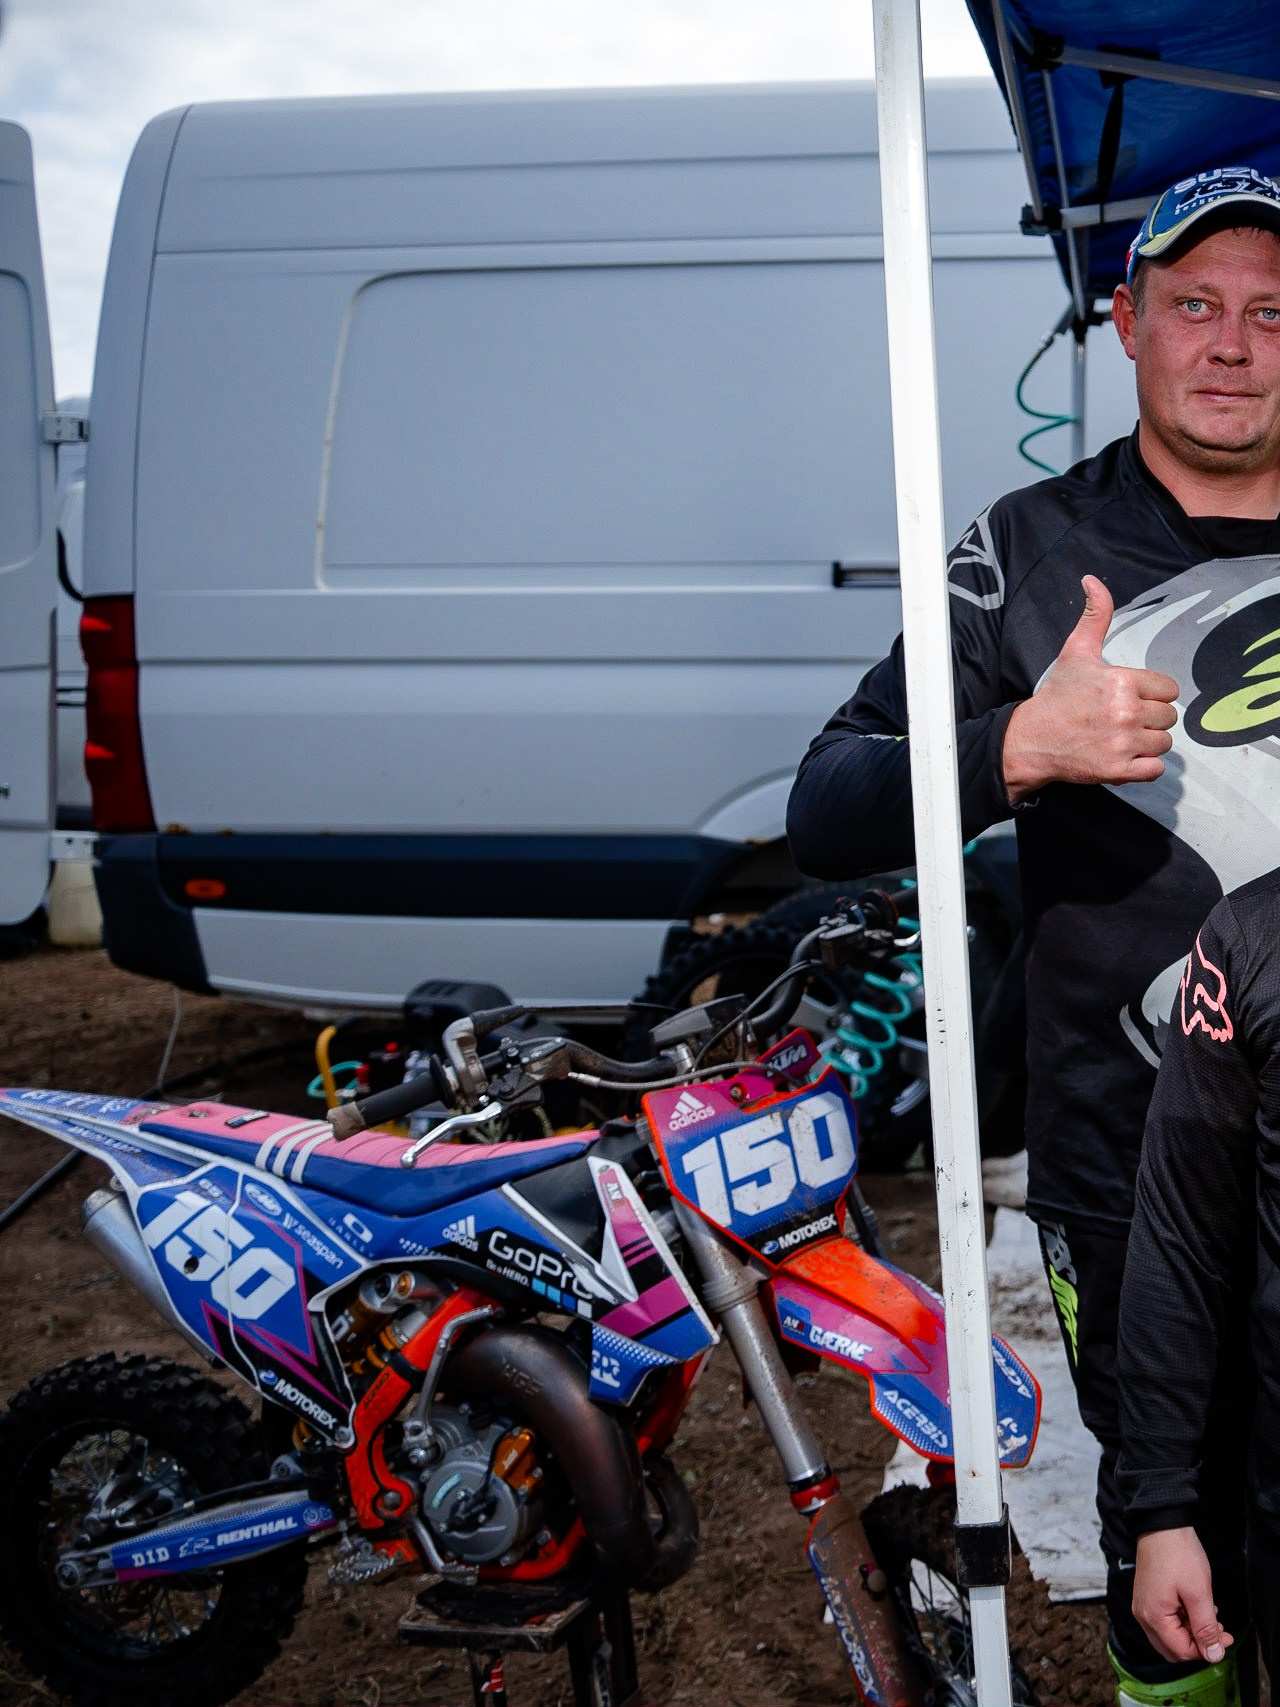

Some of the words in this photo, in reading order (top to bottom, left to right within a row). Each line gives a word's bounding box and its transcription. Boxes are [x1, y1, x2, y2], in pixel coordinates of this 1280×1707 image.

[766, 1045, 808, 1077] KTM
[669, 1104, 716, 1132] adidas
[681, 1091, 856, 1228] 150
[294, 1219, 345, 1270] seaspan
[442, 1226, 479, 1253] adidas
[778, 1213, 838, 1249] MOTOREX
[142, 1190, 296, 1320] 150
[274, 1379, 338, 1429] MOTOREX
[882, 1389, 949, 1449] ACERBIS
[216, 1516, 298, 1546] RENTHAL
